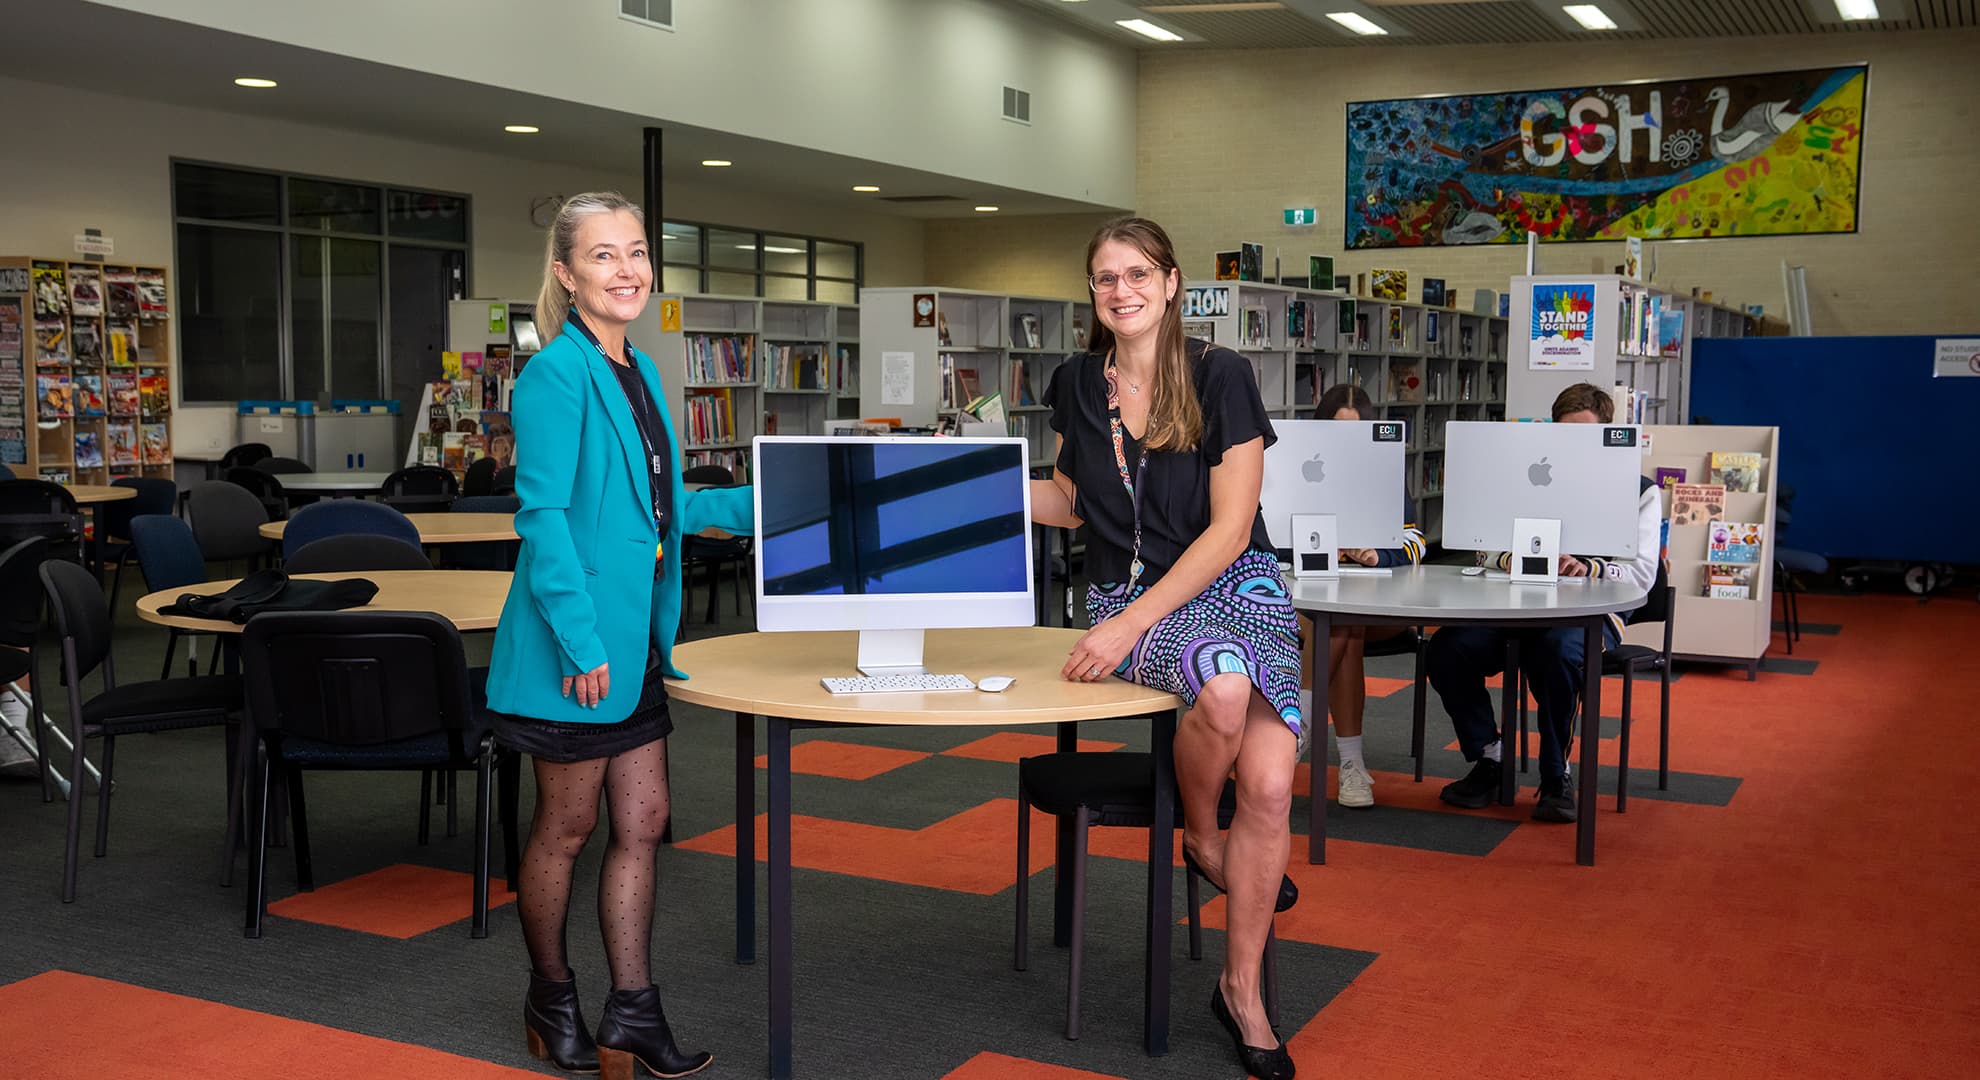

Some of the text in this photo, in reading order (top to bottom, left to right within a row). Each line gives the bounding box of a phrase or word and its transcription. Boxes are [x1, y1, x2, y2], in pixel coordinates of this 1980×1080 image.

[1182, 289, 1228, 316] TION
[1539, 311, 1588, 323] STAND
[1540, 323, 1588, 331] TOGETHER
[1941, 345, 1953, 353] NO
[1379, 425, 1396, 434] ECU
[1611, 430, 1629, 439] ECU
[1717, 455, 1758, 465] CASTLES
[1705, 489, 1724, 497] AND
[1711, 543, 1726, 551] 101
[1717, 587, 1743, 598] food
